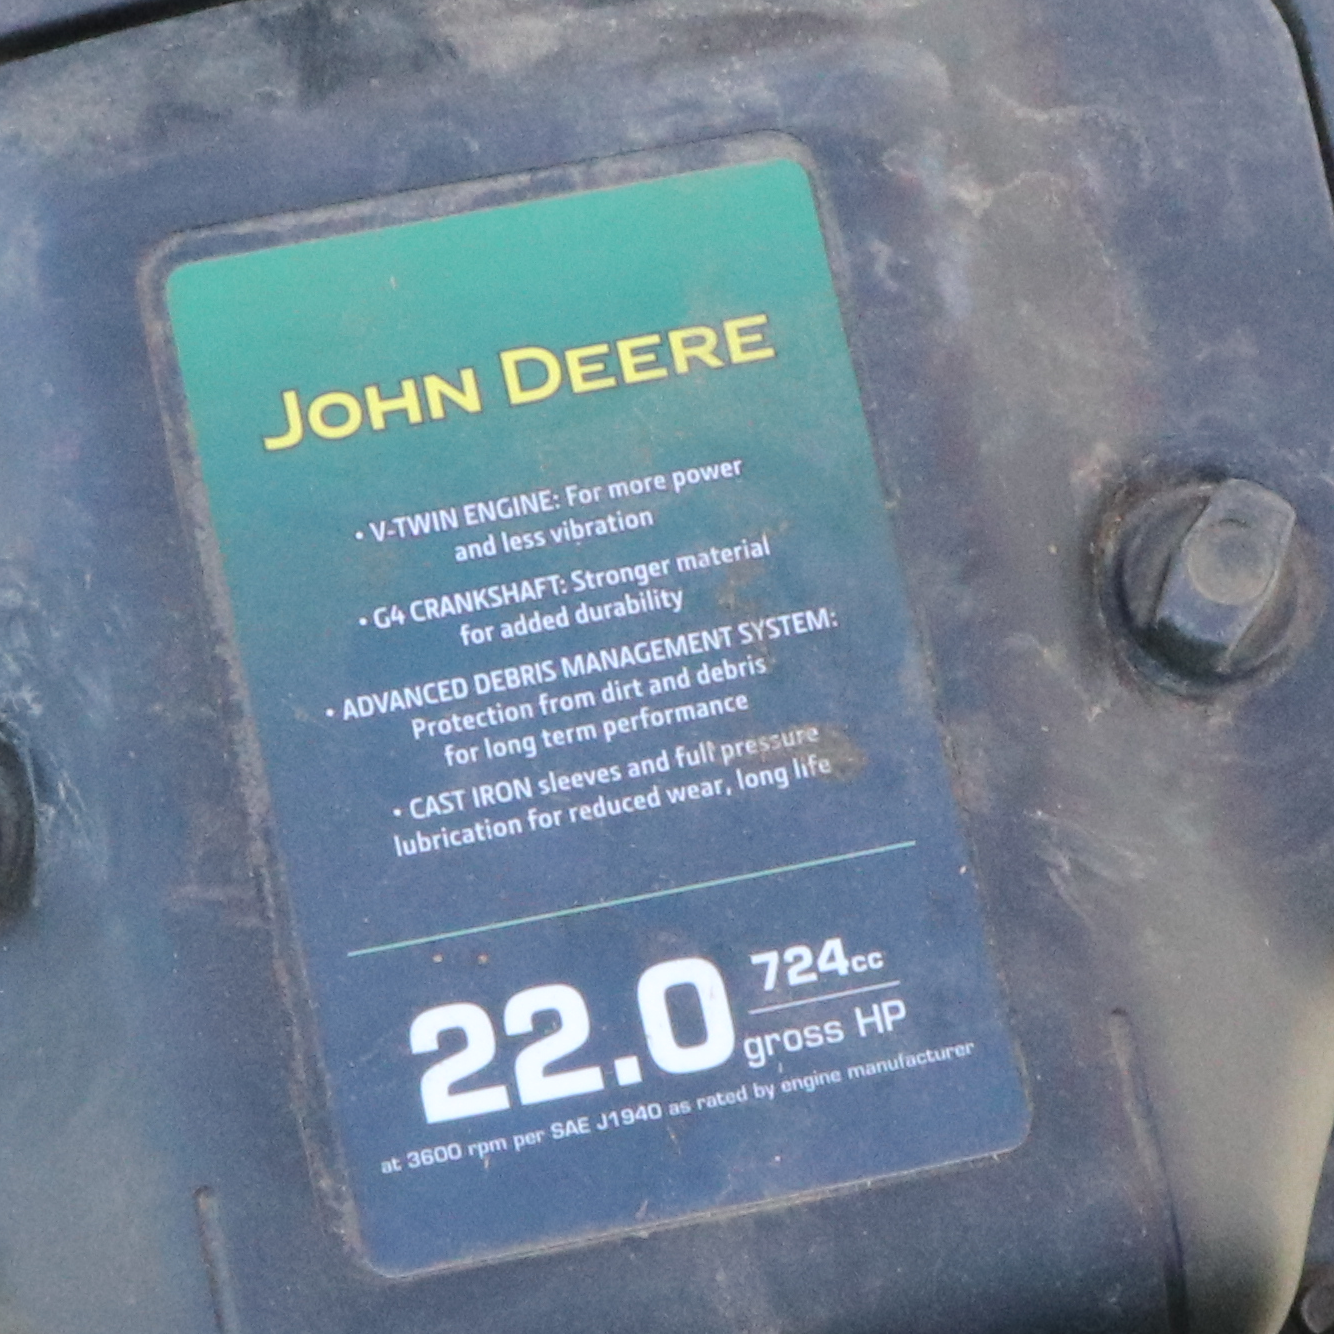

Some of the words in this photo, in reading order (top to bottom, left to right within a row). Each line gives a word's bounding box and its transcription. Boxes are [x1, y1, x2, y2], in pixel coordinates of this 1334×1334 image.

[264, 368, 482, 450] JOHN
[500, 314, 776, 404] DEERE
[369, 507, 459, 542] V-TWIN
[463, 489, 560, 526] ENGINE:
[565, 484, 602, 506] For
[608, 474, 667, 499] more
[672, 459, 742, 493] power
[454, 534, 497, 562] and
[501, 529, 546, 553] less
[550, 509, 655, 544] vibration
[373, 604, 405, 629] G4
[410, 574, 567, 622] CRANKSHAFT:
[570, 556, 670, 593] Stronger
[676, 531, 770, 572] material
[460, 623, 494, 646] for
[500, 605, 570, 639] added
[575, 587, 683, 625] durability
[343, 677, 469, 720] ADVANCED
[473, 660, 557, 695] DEBRIS
[560, 625, 733, 678] MANAGEMENT
[738, 607, 839, 645] SYSTEM:
[411, 702, 534, 740] Protection
[539, 689, 596, 716] from
[601, 677, 644, 704] dirt
[649, 667, 691, 696] and
[696, 654, 767, 684] debris
[409, 789, 465, 819] CAST
[471, 776, 533, 808] IRON
[538, 764, 622, 795] sleeves
[627, 749, 670, 779] and
[675, 740, 715, 768] full
[720, 726, 819, 766] pressure
[444, 744, 479, 767] for
[484, 735, 537, 759] long
[542, 723, 597, 747] term
[603, 693, 749, 741] performance
[393, 818, 523, 857] lubrication
[527, 808, 562, 831] for
[569, 784, 661, 822] reduced
[666, 778, 732, 805] wear,
[735, 768, 789, 791] long
[792, 754, 832, 780] life
[750, 937, 884, 992] 724cc
[410, 957, 735, 1124] 22.0
[744, 1020, 845, 1069] gross
[854, 999, 907, 1038] HP
[381, 1157, 402, 1174] at
[406, 1142, 462, 1169] 3600
[467, 1136, 507, 1159] rpm
[513, 1129, 545, 1152] per
[550, 1117, 591, 1140] SAE
[596, 1102, 663, 1130] J1940
[669, 1100, 691, 1116] as
[696, 1084, 748, 1111] rated
[752, 1081, 775, 1101] by
[780, 1068, 843, 1094] engine
[847, 1041, 975, 1080] manufacturer
